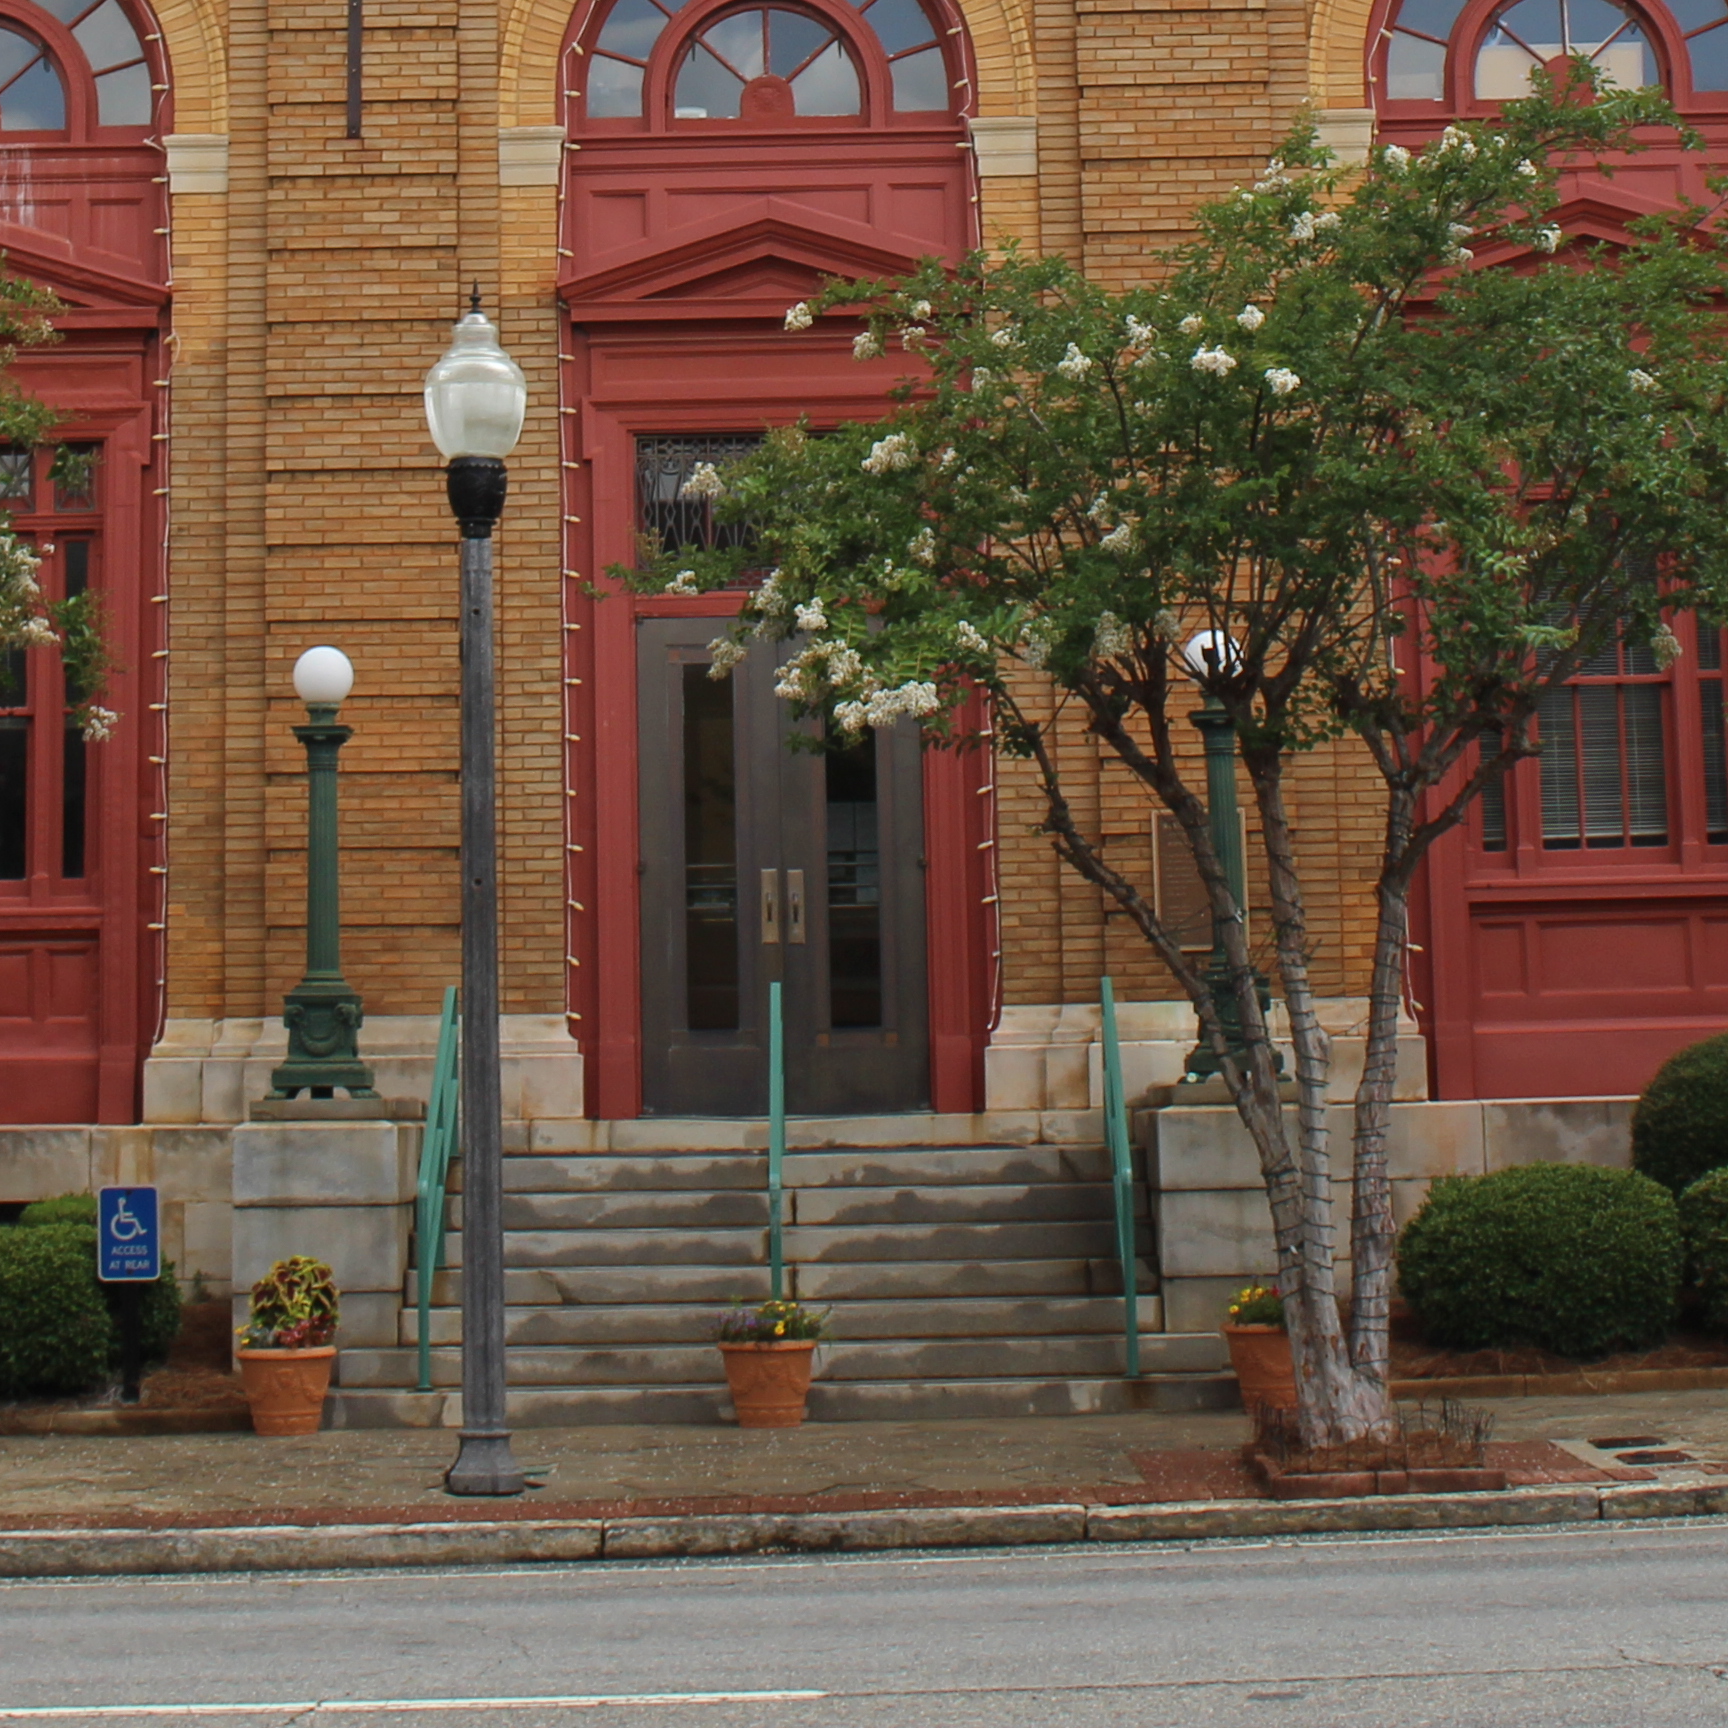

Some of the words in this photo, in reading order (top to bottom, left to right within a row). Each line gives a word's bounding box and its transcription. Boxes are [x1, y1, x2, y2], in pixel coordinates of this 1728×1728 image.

[111, 1245, 149, 1256] ACCESS
[109, 1260, 121, 1270] AT
[124, 1259, 151, 1270] REAR
